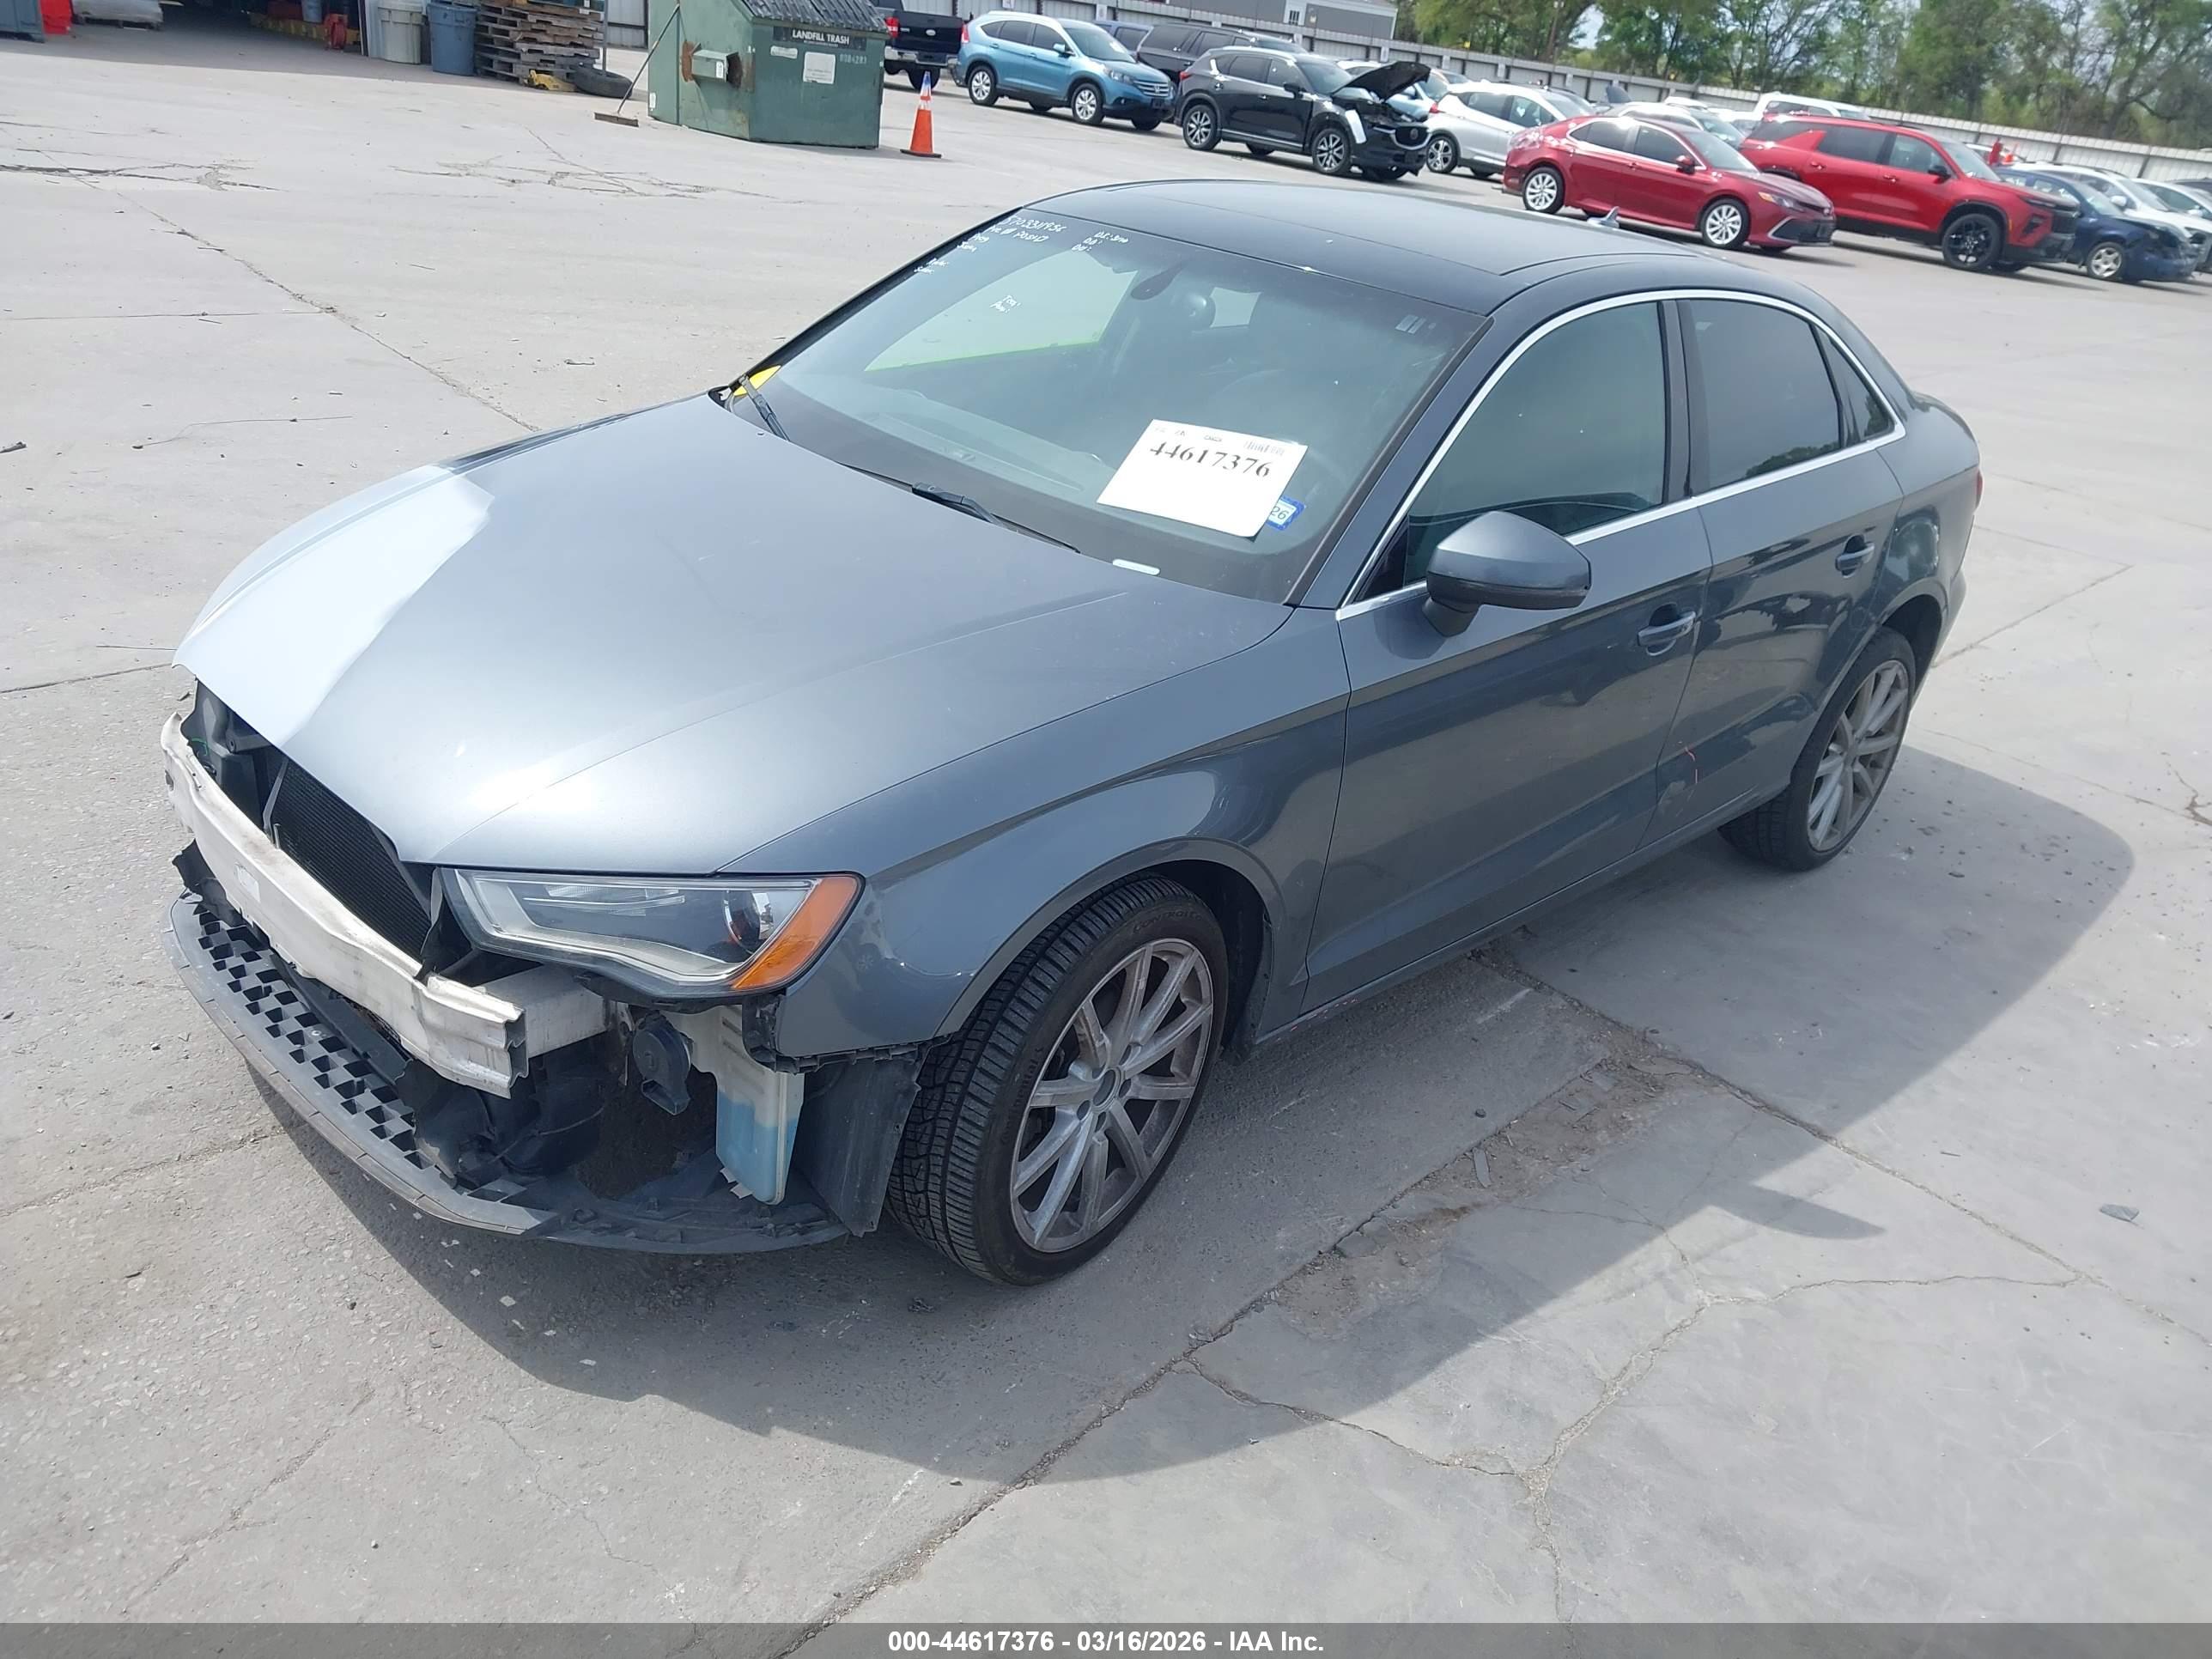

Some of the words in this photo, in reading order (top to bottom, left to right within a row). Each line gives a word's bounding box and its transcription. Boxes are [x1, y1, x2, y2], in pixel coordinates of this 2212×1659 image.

[792, 29, 824, 42] LANDFILL
[826, 34, 850, 45] TRASH
[1150, 441, 1273, 477] 44617376
[1271, 506, 1290, 520] 26
